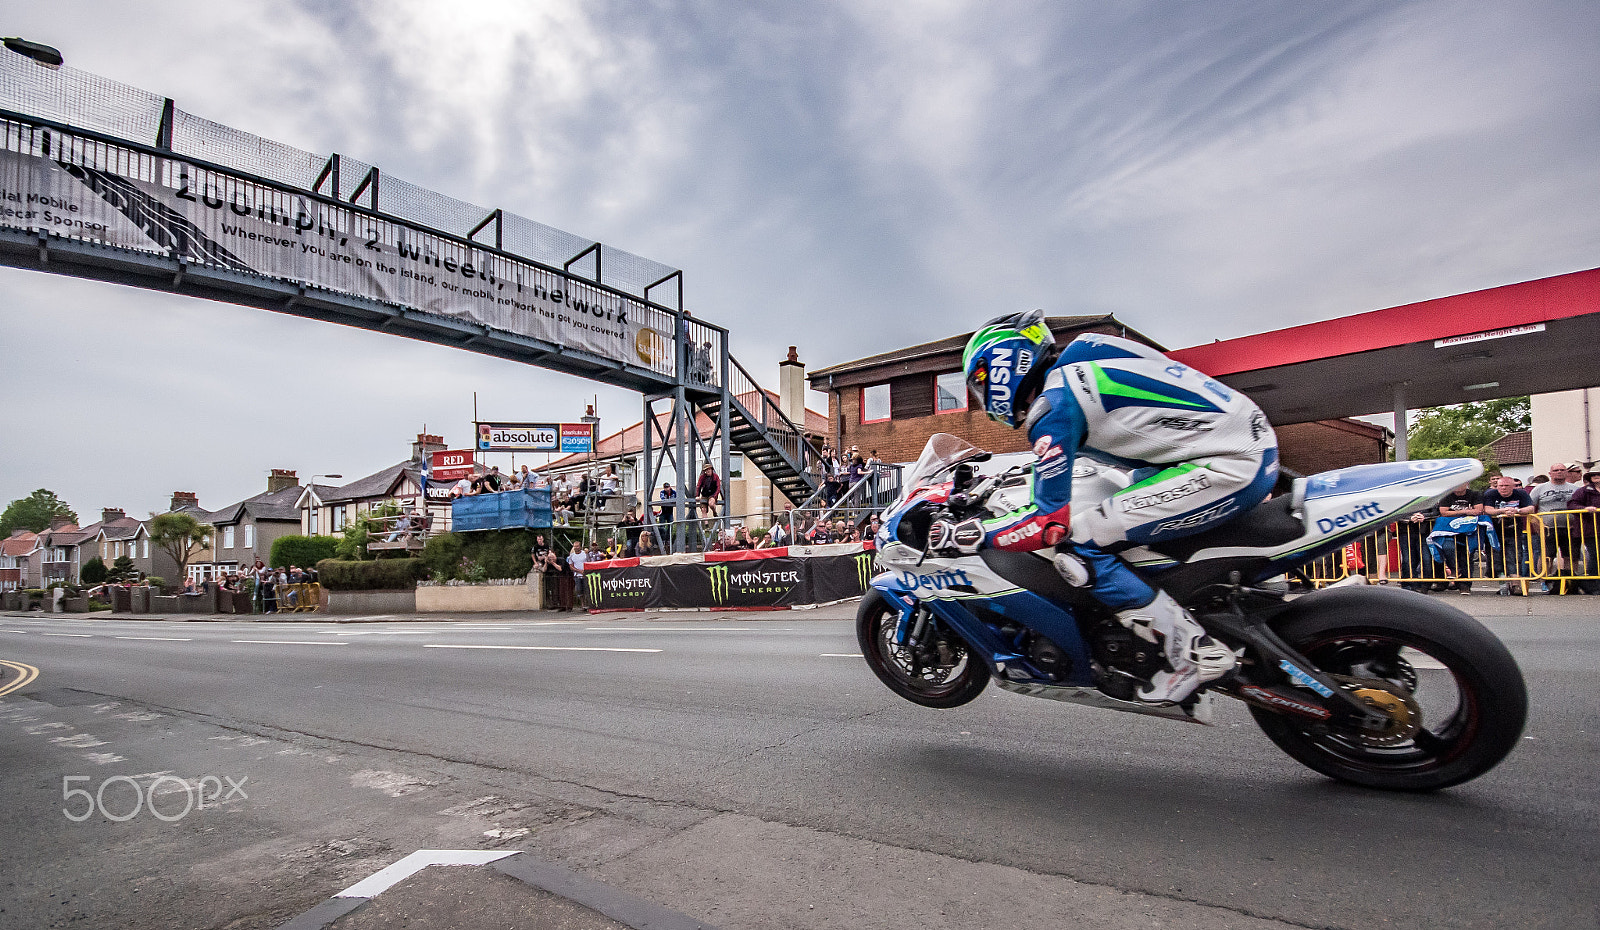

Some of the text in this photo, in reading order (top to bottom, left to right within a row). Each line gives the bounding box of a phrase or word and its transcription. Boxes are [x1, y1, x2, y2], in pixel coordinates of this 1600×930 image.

[0, 189, 79, 212] ial Mobile
[43, 210, 109, 232] Sponsor
[221, 223, 297, 248] Wherever
[301, 243, 326, 257] you
[330, 252, 351, 264] are
[355, 258, 372, 268] on
[376, 262, 397, 275] the
[400, 267, 438, 287] island,
[441, 281, 459, 292] our
[462, 287, 495, 303] mobile
[497, 297, 537, 314] network
[539, 306, 555, 319] has
[557, 314, 571, 325] got
[573, 319, 589, 330] you
[989, 347, 1014, 403] USN
[493, 430, 554, 443] absolute
[443, 455, 464, 466] RED
[1121, 474, 1212, 513] Kawasaki
[1316, 501, 1385, 535] Devitt
[997, 521, 1043, 548] MOTUL
[602, 577, 652, 592] MONSTER
[730, 570, 800, 587] MONSTER
[896, 568, 973, 591] Devitt
